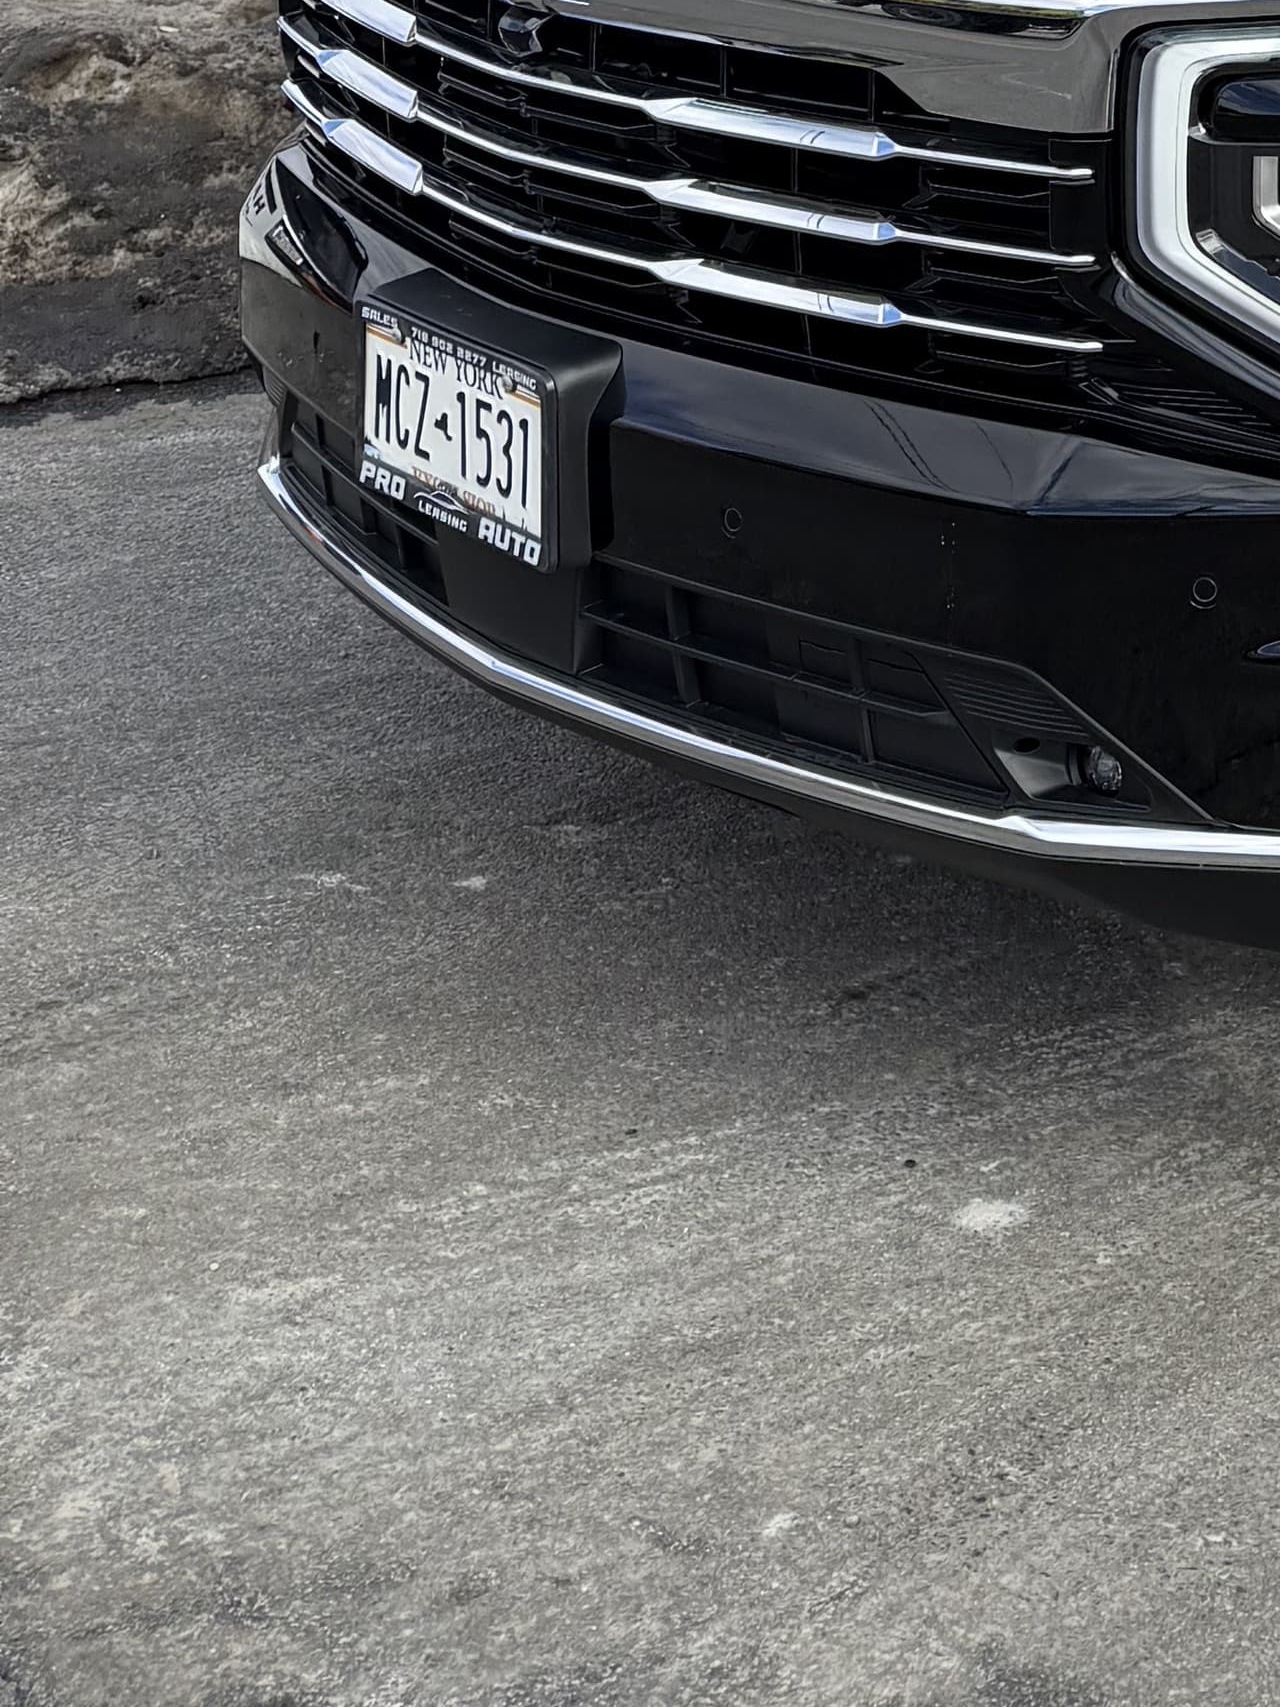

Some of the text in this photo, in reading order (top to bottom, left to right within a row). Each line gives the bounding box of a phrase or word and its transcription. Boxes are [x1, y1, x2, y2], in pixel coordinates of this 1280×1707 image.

[361, 307, 398, 327] SALES
[409, 338, 503, 400] NEW YORK
[410, 327, 429, 342] 718
[492, 361, 537, 390] LEASING
[375, 351, 528, 509] MCZ 1531
[359, 460, 406, 501] PRO
[418, 499, 468, 533] LEASING
[478, 516, 541, 567] AUTO
